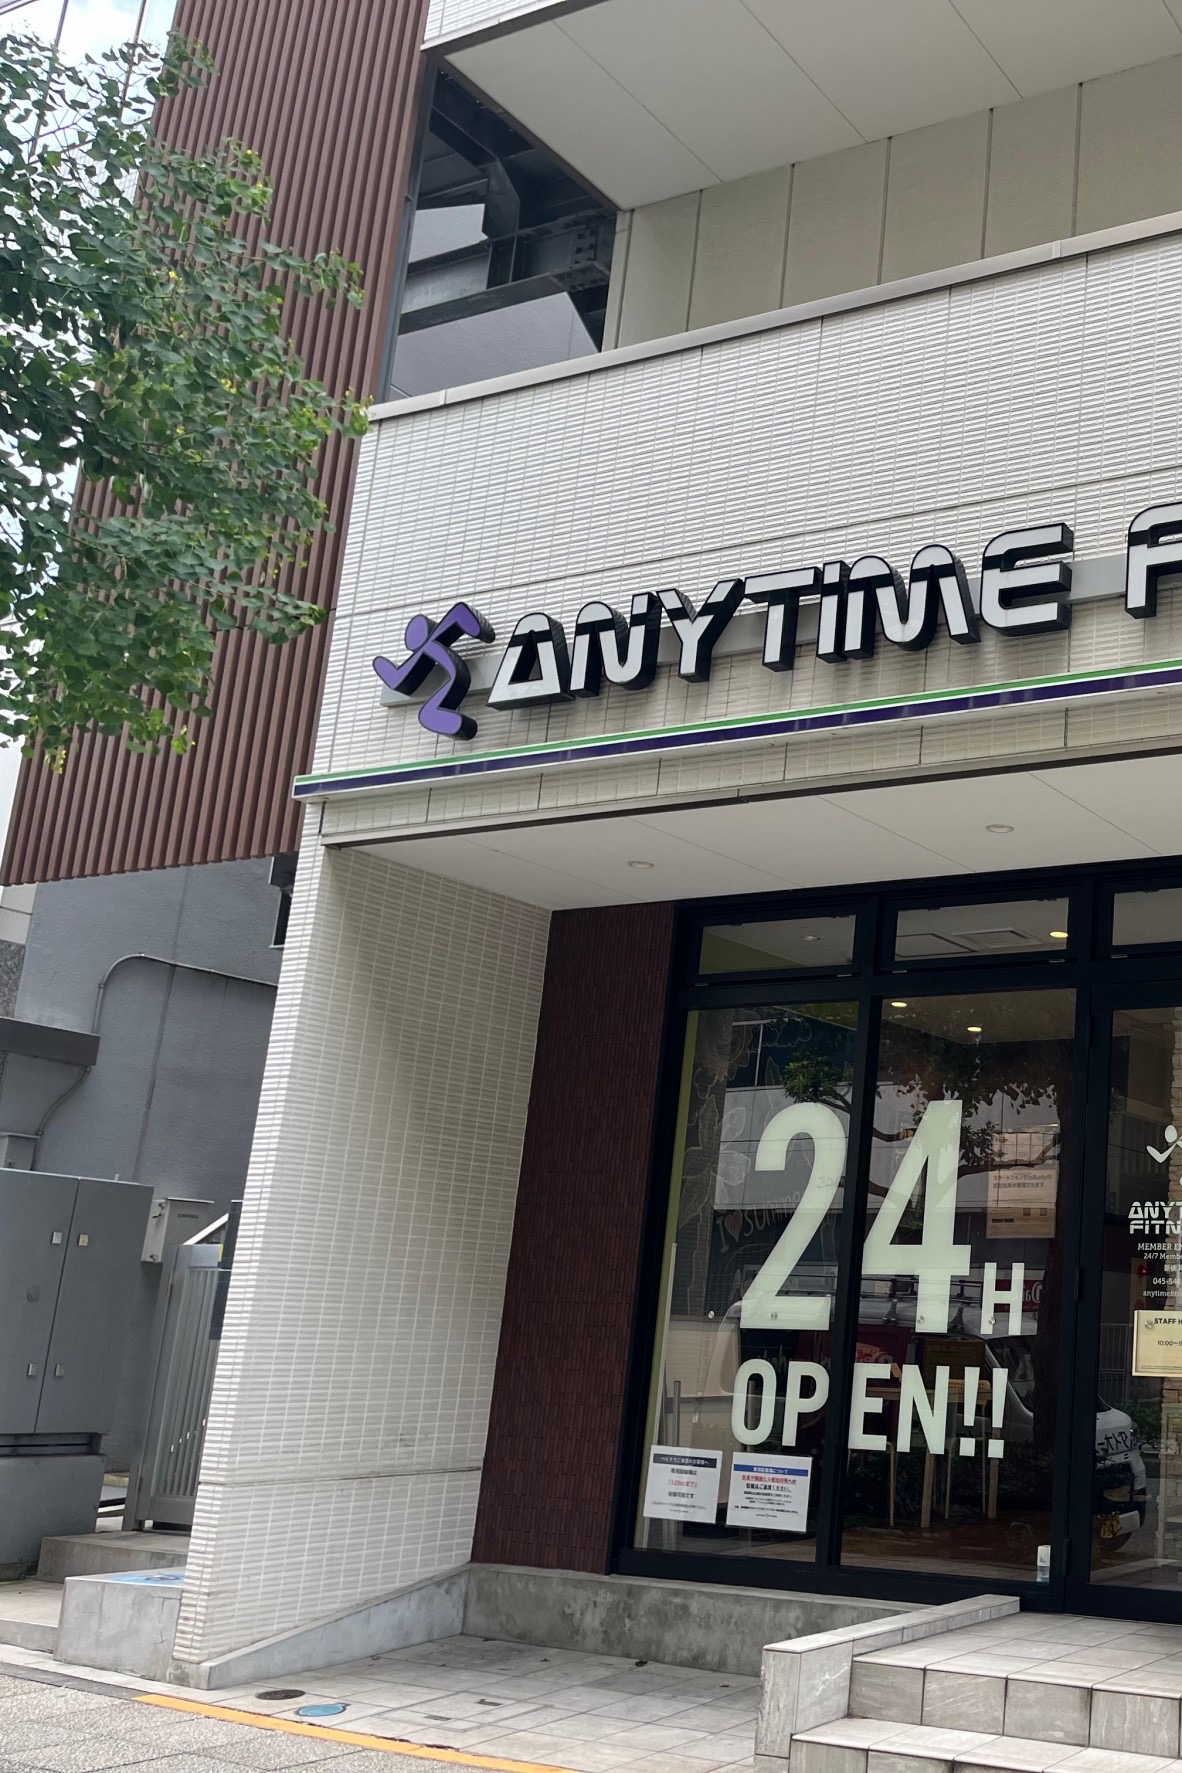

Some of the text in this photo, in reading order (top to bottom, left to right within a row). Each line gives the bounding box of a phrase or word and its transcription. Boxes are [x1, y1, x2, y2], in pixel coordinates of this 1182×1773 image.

[487, 521, 1074, 711] ANYTIME
[1137, 1242, 1173, 1251] MEMBER
[1143, 1252, 1159, 1260] 24/7
